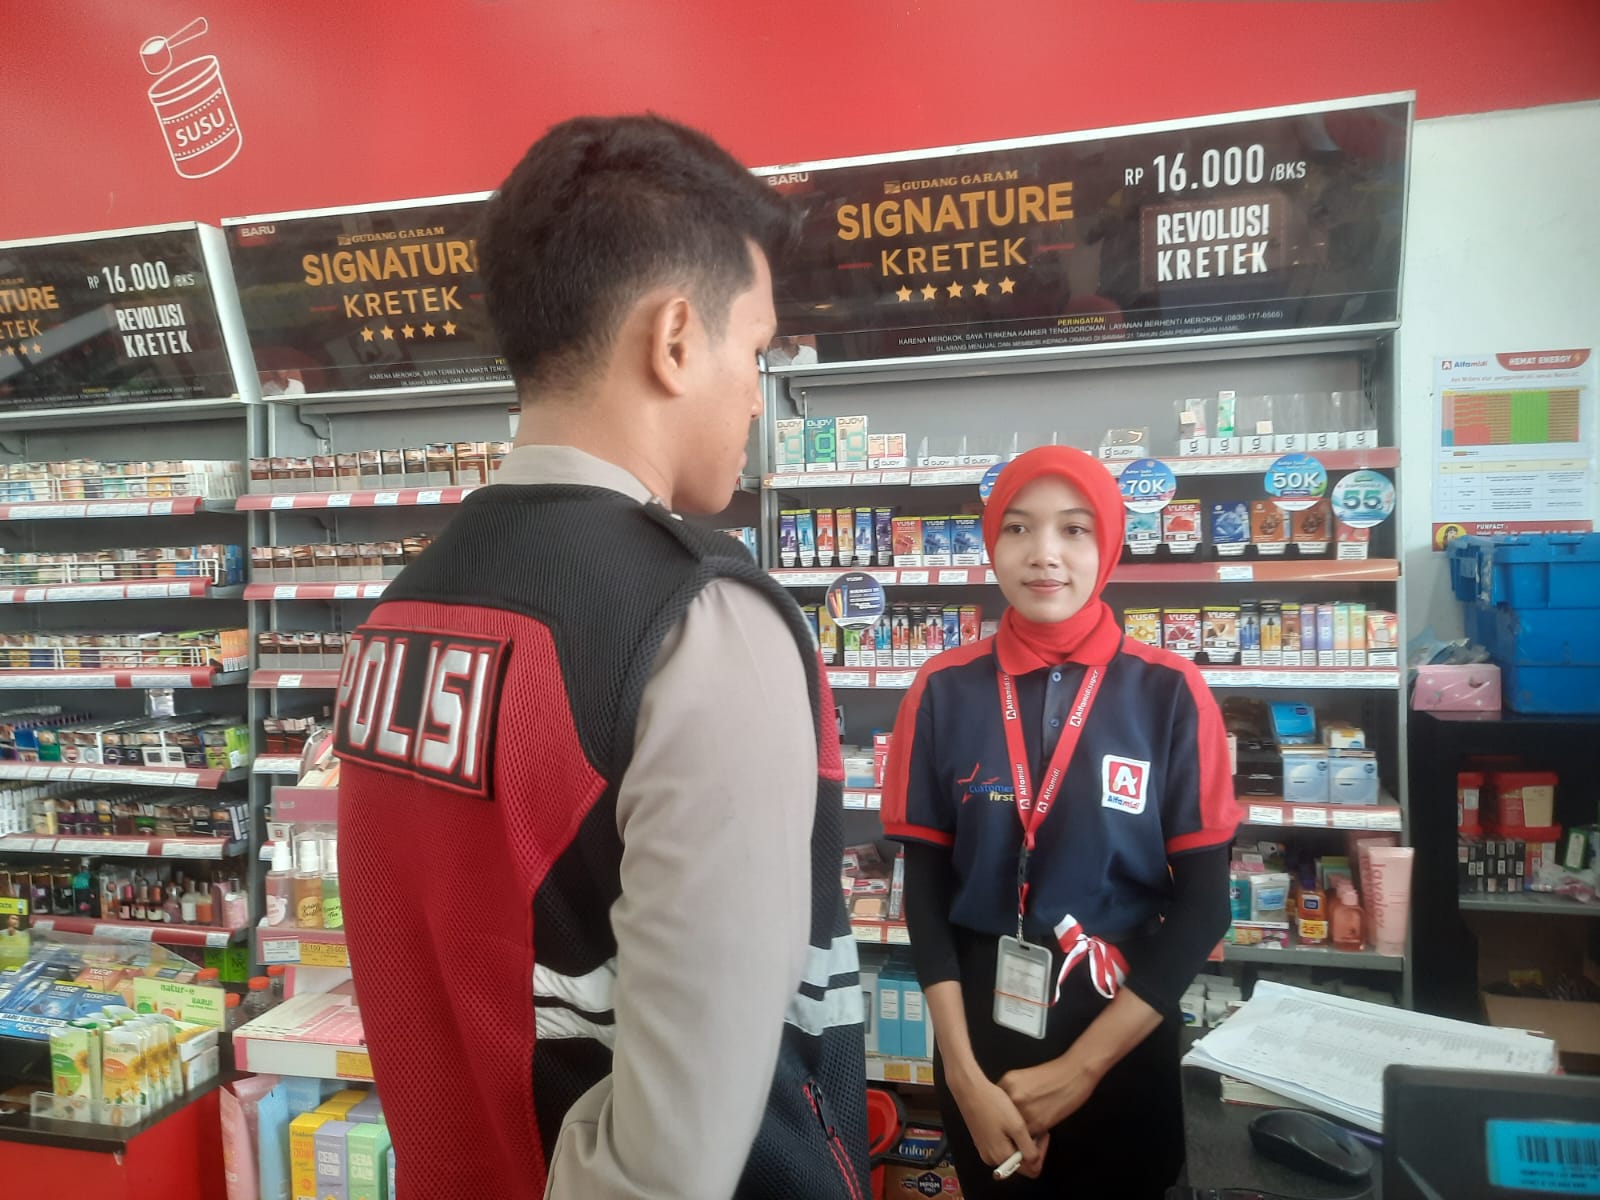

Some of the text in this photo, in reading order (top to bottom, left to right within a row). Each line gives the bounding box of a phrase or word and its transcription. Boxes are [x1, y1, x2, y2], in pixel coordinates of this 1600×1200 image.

[175, 107, 225, 147] SUSU
[767, 172, 809, 186] BARU
[902, 169, 1019, 191] GUDANG GARAM
[1124, 143, 1307, 194] RP 16.000 /BKS
[836, 181, 1075, 241] SIGNATURE
[240, 224, 276, 238] BARU
[351, 226, 445, 243] GUDANG GARAM
[881, 236, 1028, 277] KRETEK
[1157, 240, 1269, 282] KRETEK
[86, 275, 100, 290] RP
[101, 260, 171, 294] 16.000
[343, 285, 463, 319] KRETEK
[0, 318, 43, 341] TEK
[115, 303, 187, 332] REVOLUSI
[1057, 316, 1105, 326] PERINGATAN
[1143, 318, 1183, 329] BERHENTI
[122, 329, 193, 359] KRETEK
[1126, 478, 1167, 495] 70K
[1272, 471, 1321, 489] 50K
[335, 637, 491, 780] POLISI
[1016, 763, 1028, 796] Alfamidi
[1043, 768, 1061, 801] Alfamidi
[989, 790, 1015, 802] first
[1107, 795, 1141, 810] Alfamidi
